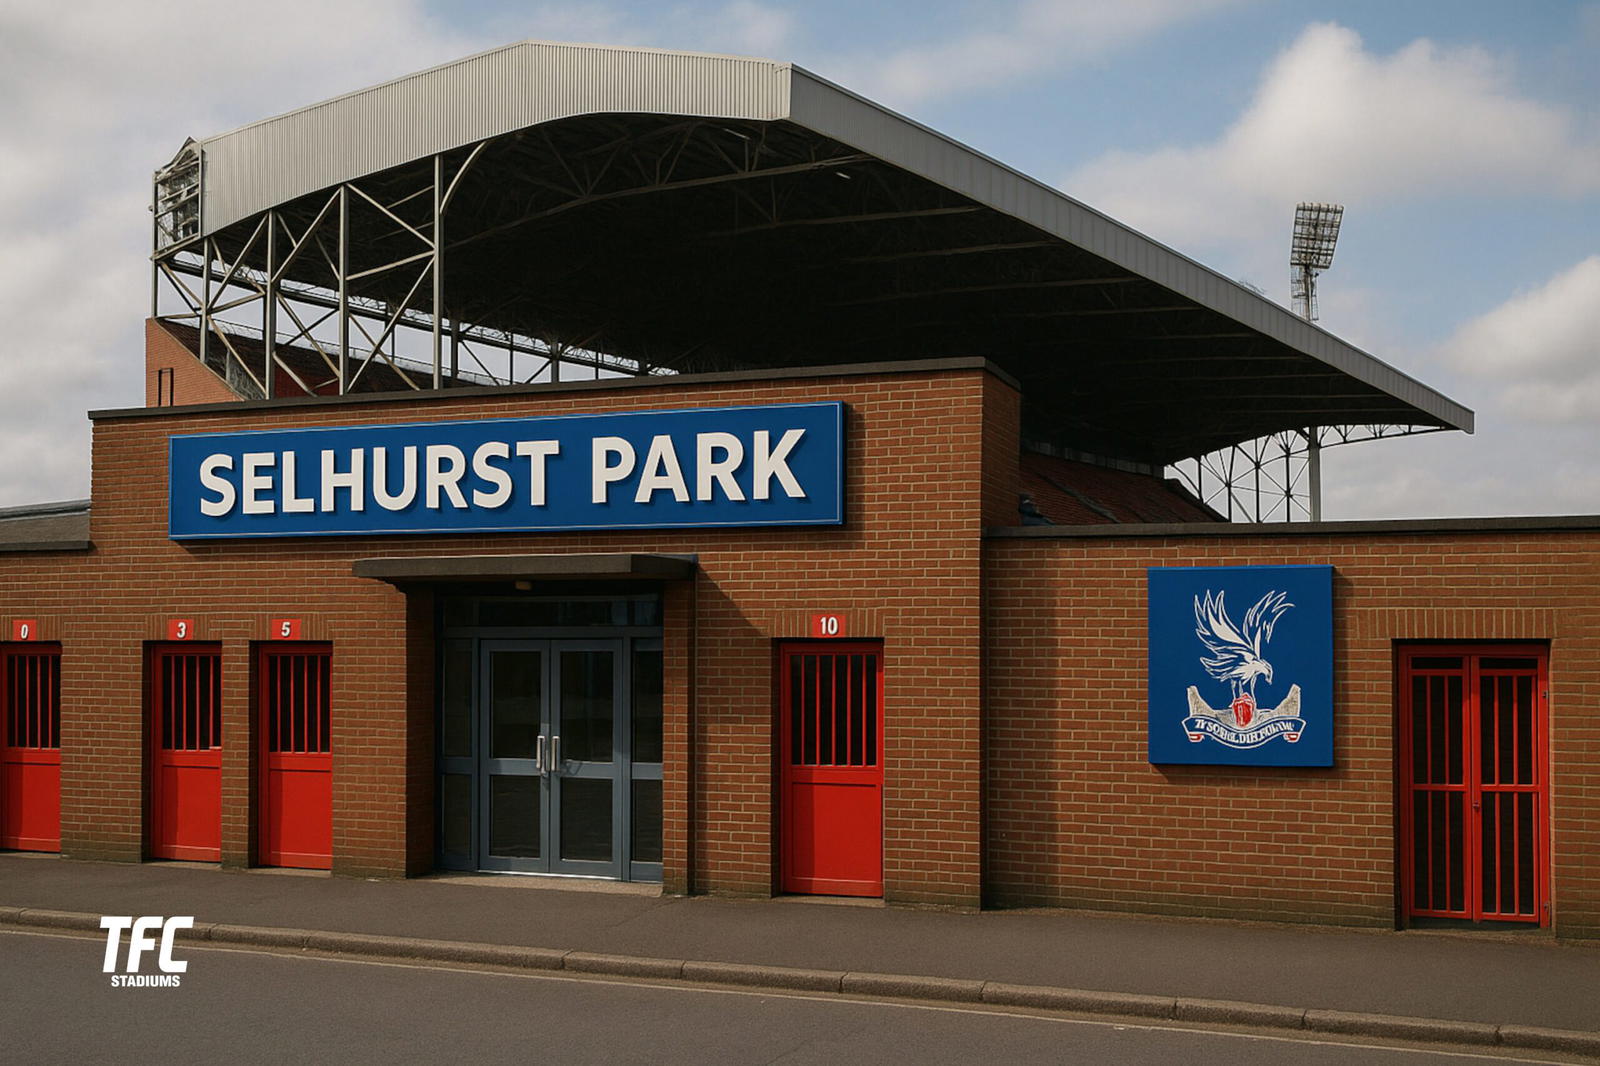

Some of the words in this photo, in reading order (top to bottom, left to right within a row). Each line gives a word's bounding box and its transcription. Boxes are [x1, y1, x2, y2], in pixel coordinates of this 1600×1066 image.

[200, 440, 560, 518] SELHURST
[592, 428, 807, 504] PARK
[20, 624, 28, 639] 0
[177, 622, 186, 638] 3
[281, 622, 291, 637] 5
[820, 616, 838, 635] 10
